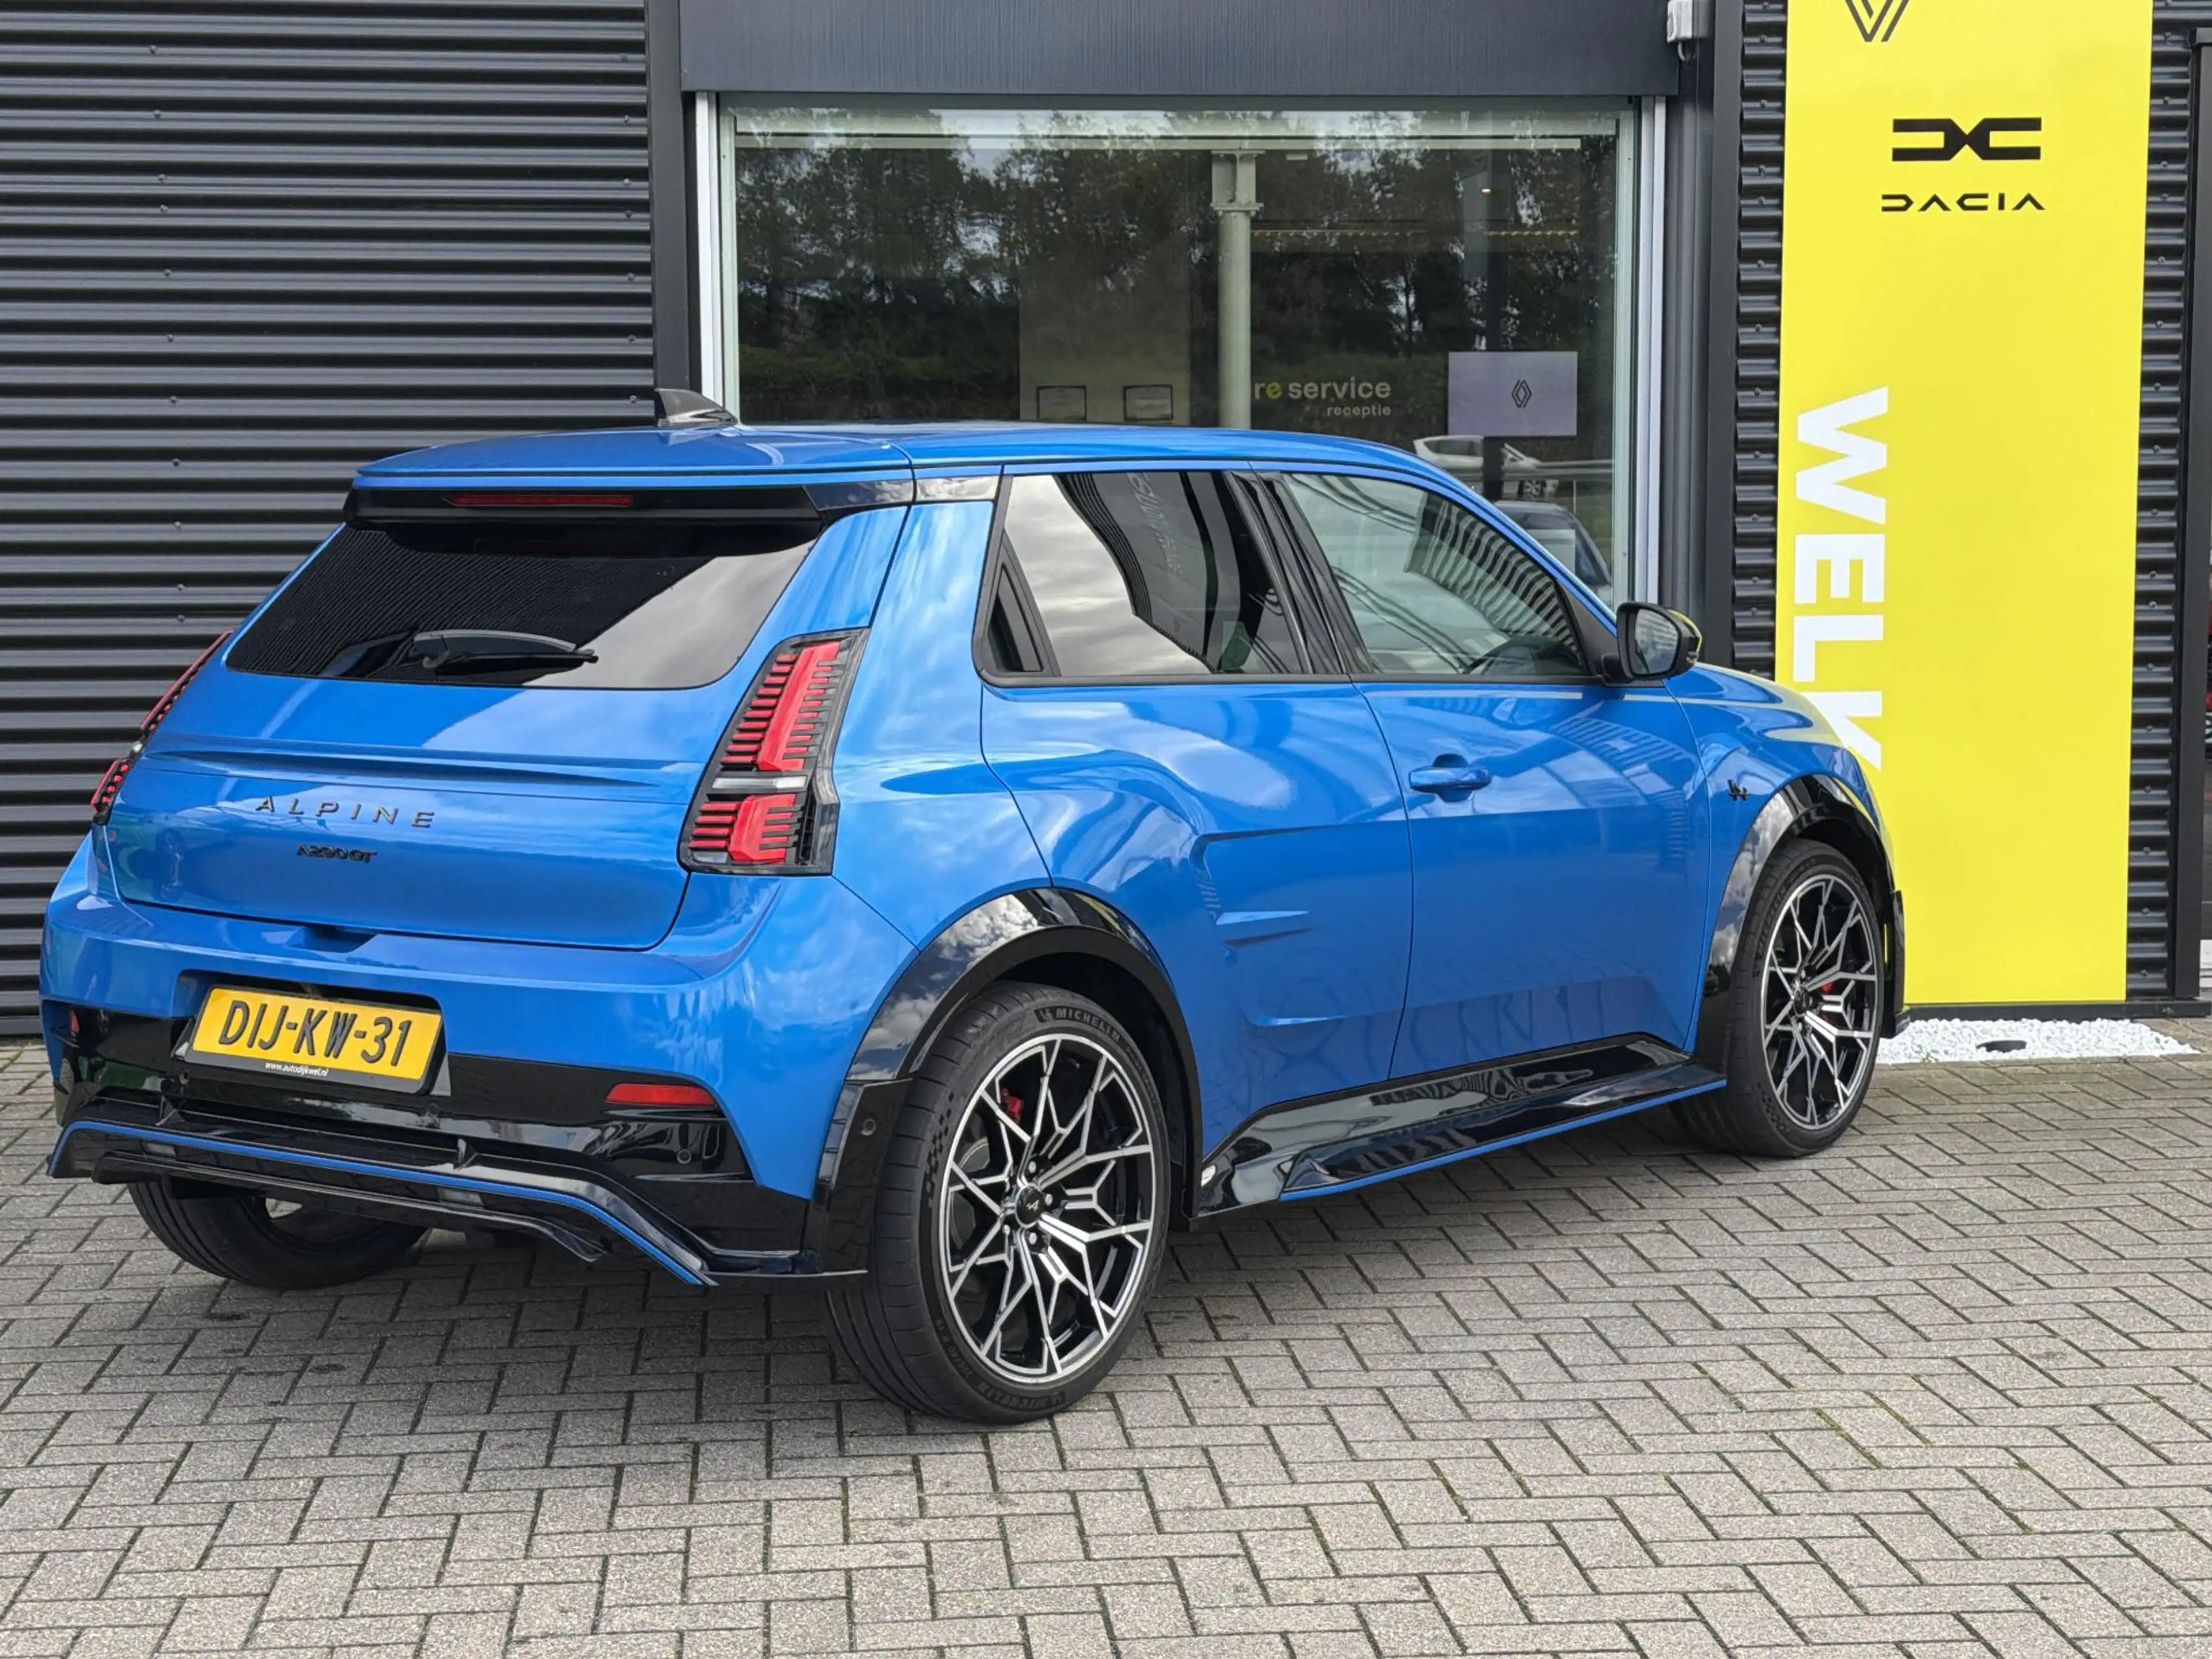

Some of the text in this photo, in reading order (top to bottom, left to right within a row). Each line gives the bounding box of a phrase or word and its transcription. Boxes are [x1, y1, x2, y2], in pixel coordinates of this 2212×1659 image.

[1881, 193, 2046, 212] DACIA
[1254, 376, 1391, 399] re service
[1327, 404, 1392, 419] receptie
[255, 796, 435, 828] ALPINE
[218, 1000, 412, 1067] DIJ-KW-31
[1056, 1007, 1121, 1043] MICHELIN
